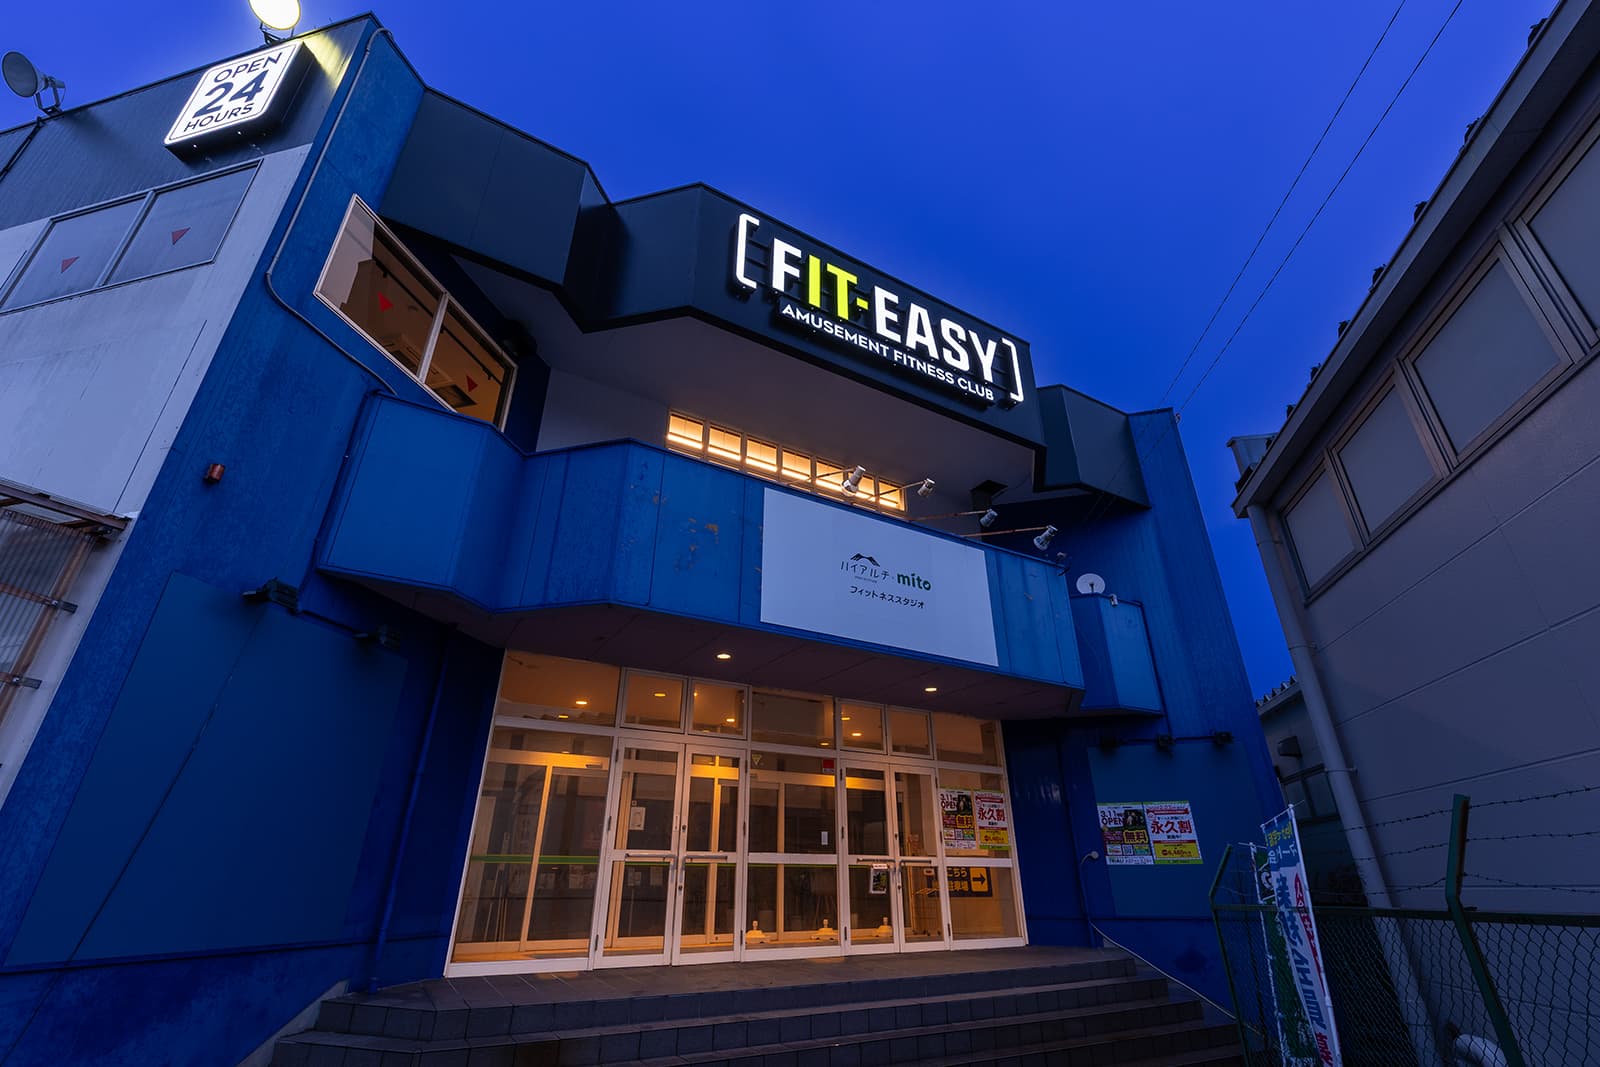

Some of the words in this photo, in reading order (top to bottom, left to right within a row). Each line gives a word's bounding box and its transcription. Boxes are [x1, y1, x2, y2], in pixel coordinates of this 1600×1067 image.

[213, 52, 283, 83] OPEN
[192, 69, 270, 119] 24
[183, 102, 254, 132] HOURS
[781, 303, 890, 359] AMUSEMENT
[893, 347, 955, 386] FITNESS
[957, 377, 995, 402] CLUB
[897, 573, 931, 591] mito
[849, 585, 925, 609] フィットネススタジオ
[978, 807, 1006, 822] 永久割
[1101, 817, 1124, 826] OPEN
[1151, 820, 1193, 835] 永久割
